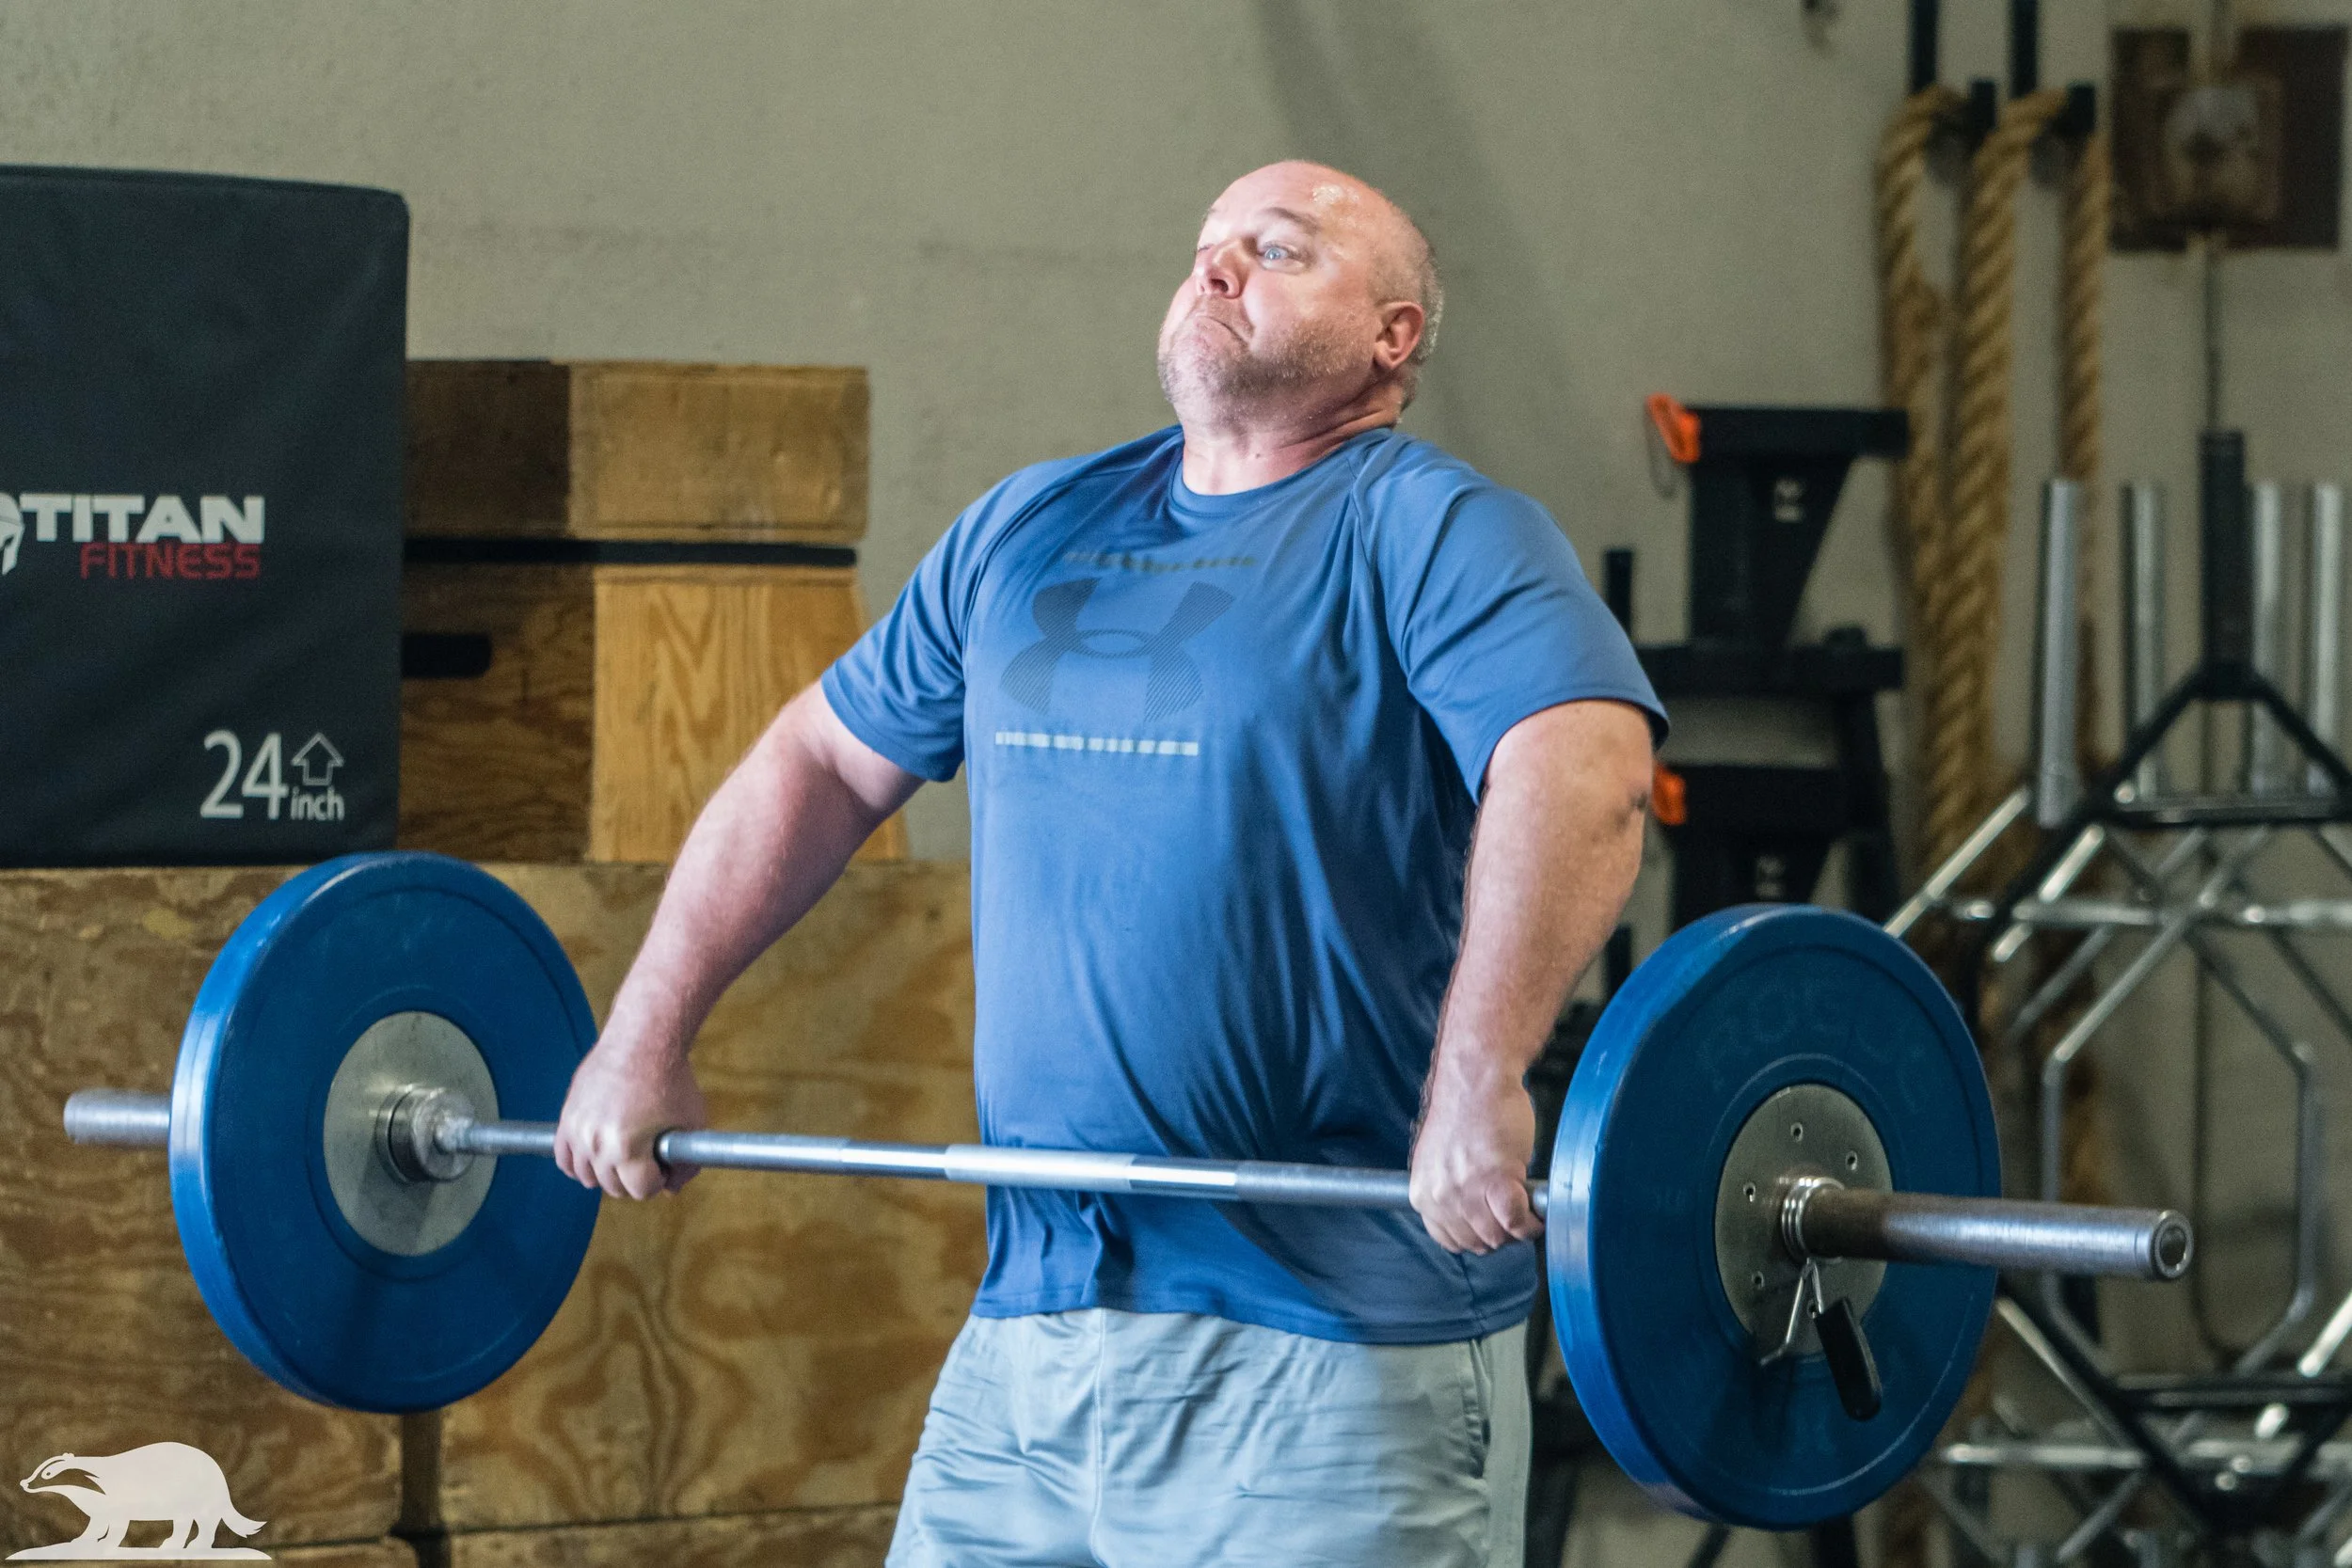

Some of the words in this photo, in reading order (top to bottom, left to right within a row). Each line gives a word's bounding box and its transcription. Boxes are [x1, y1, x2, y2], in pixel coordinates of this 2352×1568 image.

[19, 494, 265, 544] TITAN
[80, 543, 262, 579] FITNESS
[200, 730, 288, 820] 24
[291, 788, 344, 821] inch
